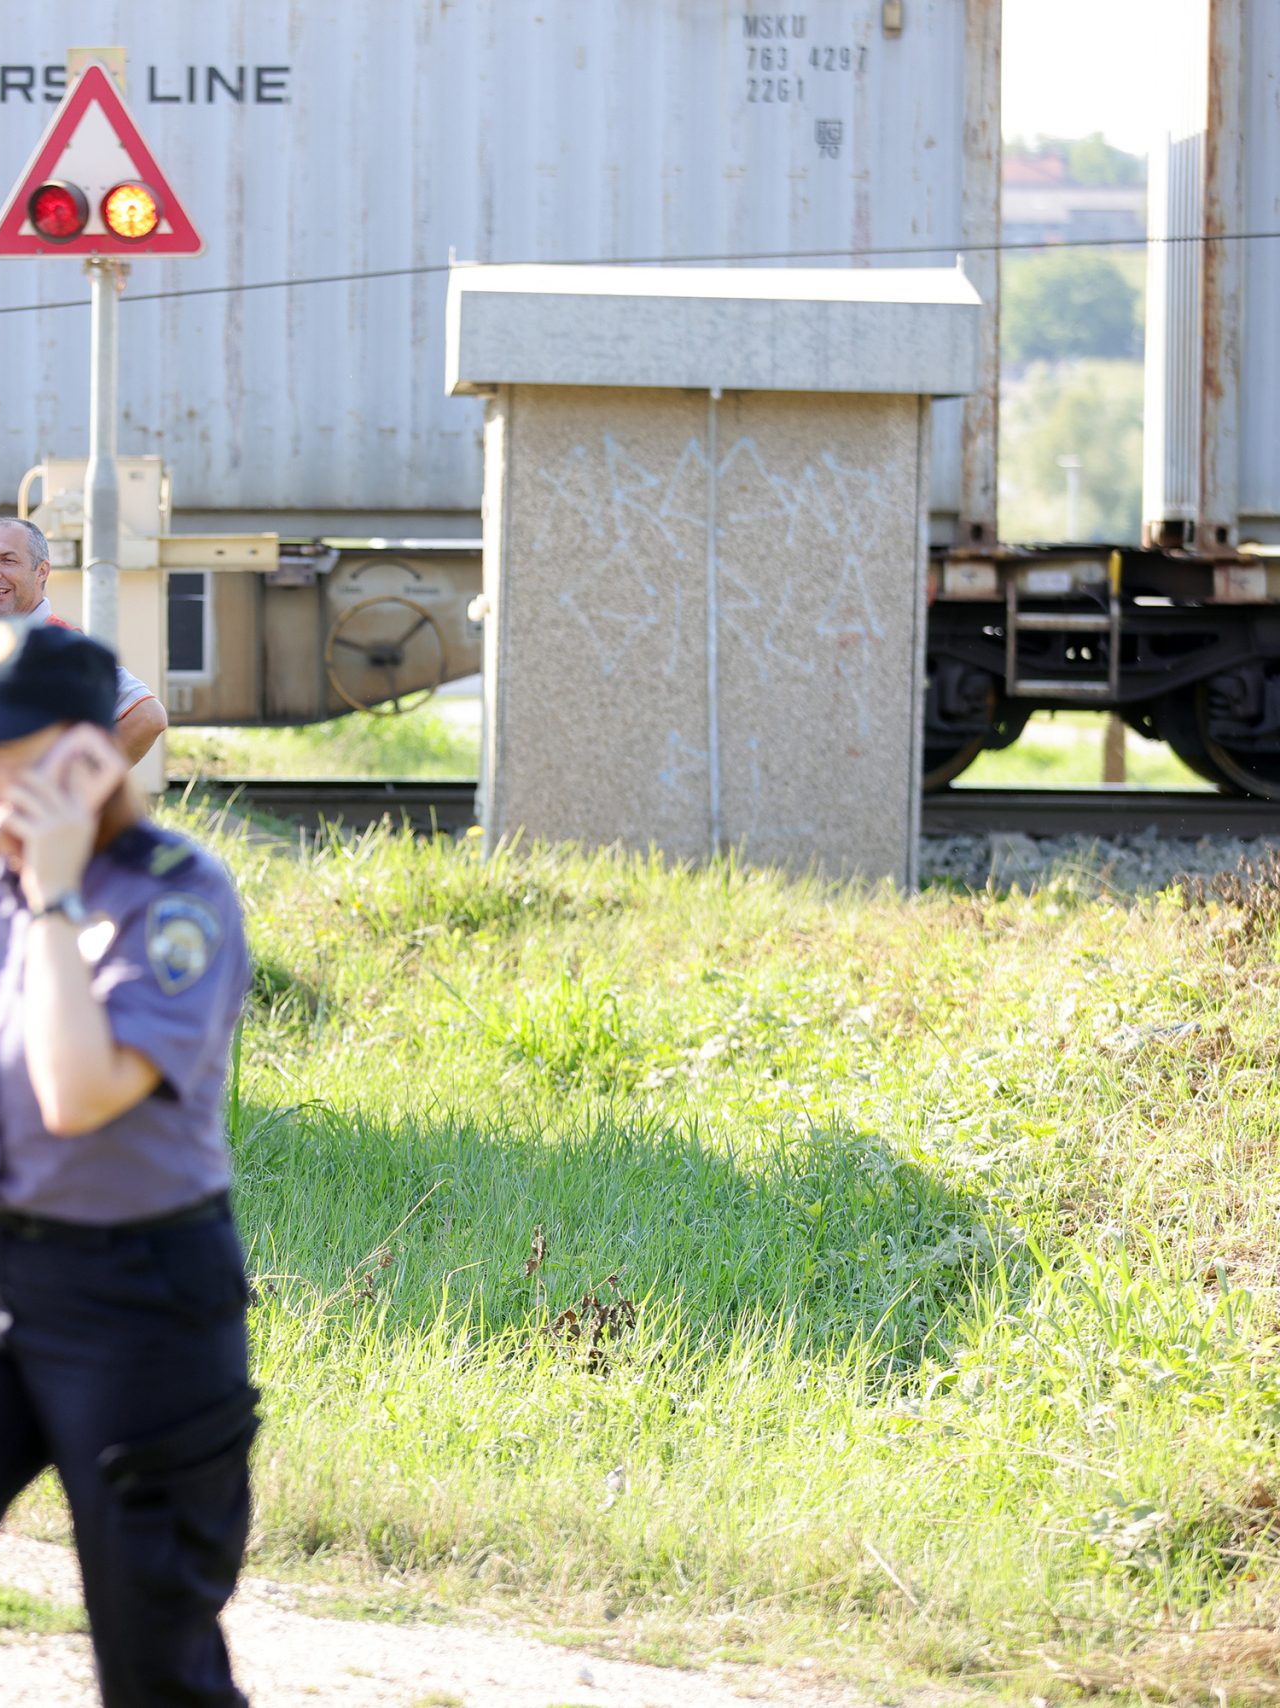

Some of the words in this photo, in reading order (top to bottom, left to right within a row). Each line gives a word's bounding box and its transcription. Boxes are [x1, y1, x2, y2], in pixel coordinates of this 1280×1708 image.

[743, 14, 807, 39] MSKU
[747, 46, 788, 72] 763
[808, 46, 868, 72] 4297
[148, 65, 291, 104] LINE
[746, 77, 804, 103] 22G1
